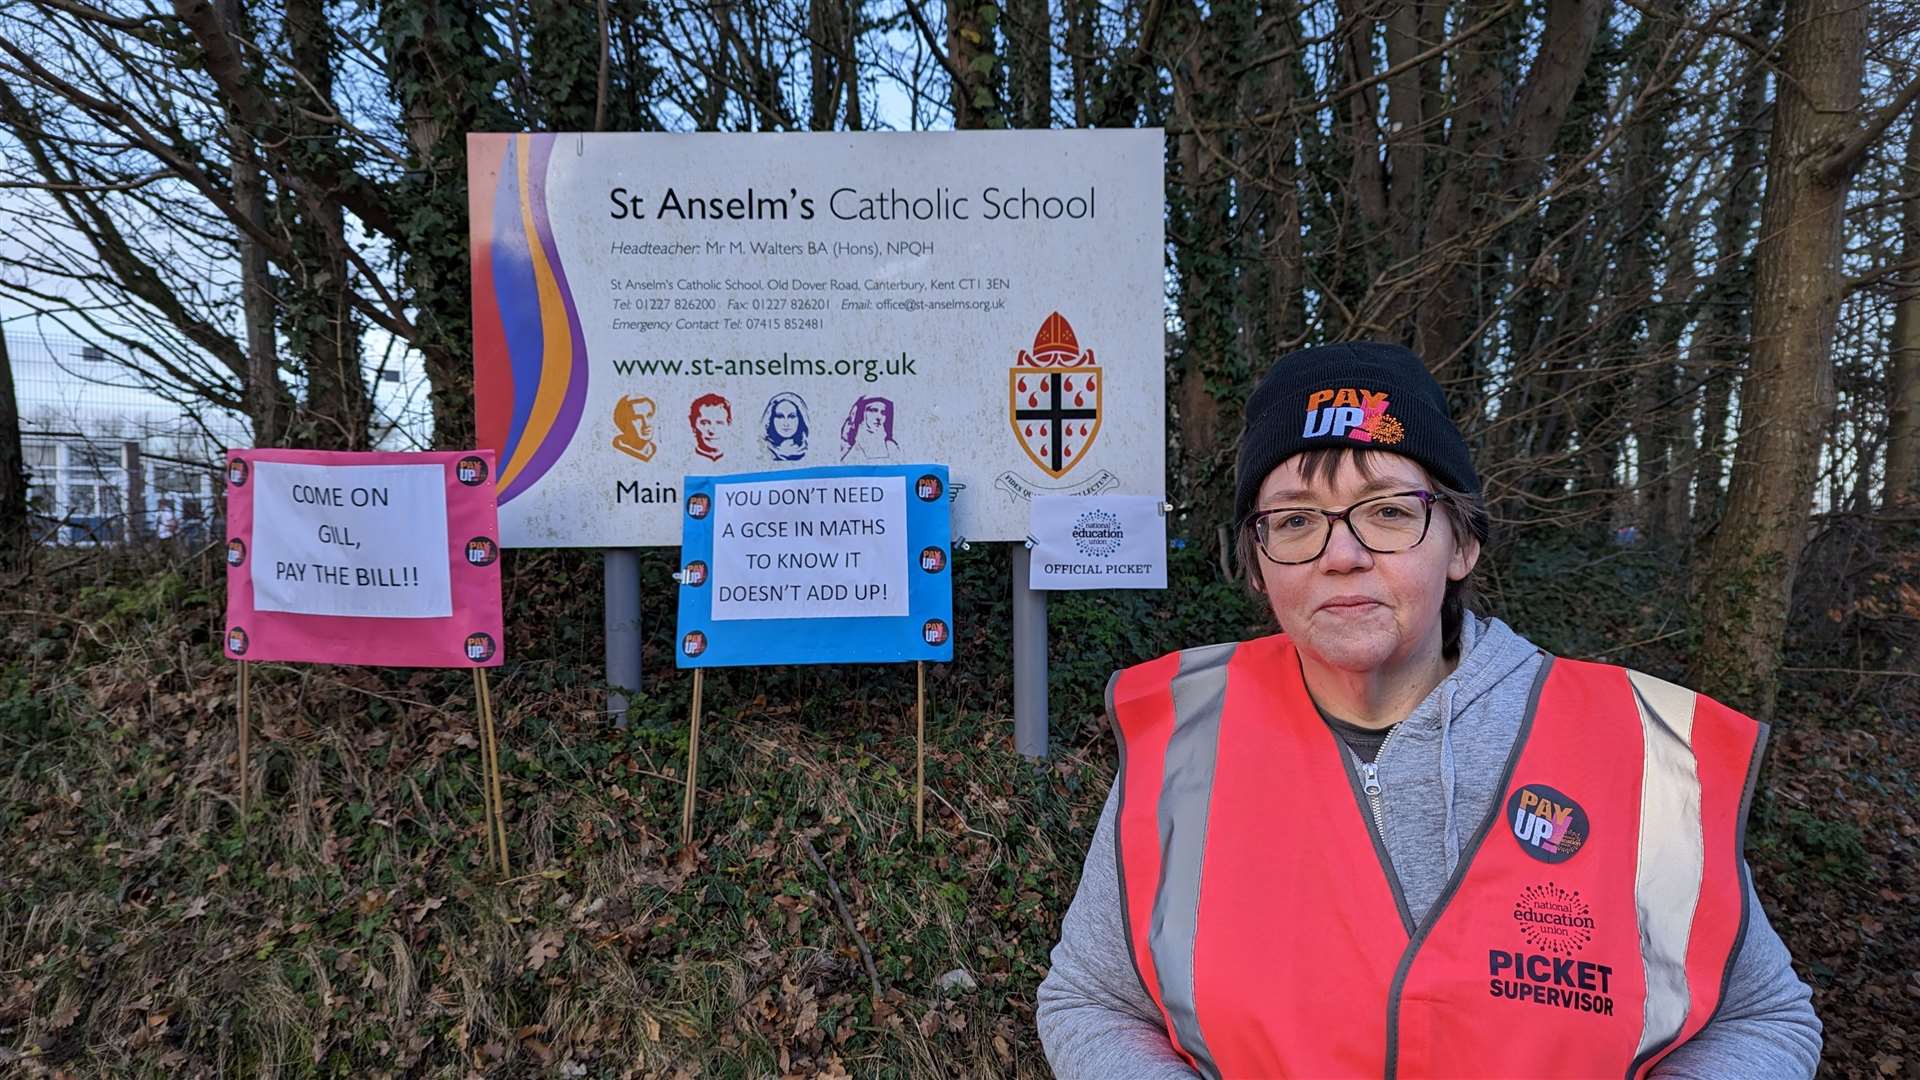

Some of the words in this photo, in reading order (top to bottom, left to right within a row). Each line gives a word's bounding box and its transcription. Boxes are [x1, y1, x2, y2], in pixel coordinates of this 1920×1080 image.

[610, 187, 645, 220] St
[656, 187, 815, 220] Anselm's
[830, 187, 969, 220] Catholic
[983, 186, 1095, 220] School
[610, 241, 701, 255] Headteacher:
[706, 241, 724, 255] Mr
[729, 241, 746, 255] M.
[749, 241, 804, 255] Walters
[807, 241, 829, 255] BA
[832, 240, 882, 258] (Hons),
[886, 241, 934, 256] NPQH
[610, 279, 622, 290] St
[624, 279, 674, 290] Anselm's
[676, 279, 722, 290] Catholic
[767, 279, 789, 290] Old
[792, 279, 827, 290] Dover
[864, 279, 928, 293] Canterbury,
[930, 279, 955, 290] Kent
[958, 278, 981, 290] CT1
[986, 278, 1010, 289] 3EN
[613, 298, 632, 310] Tel:
[635, 298, 671, 310] 01227
[674, 298, 717, 310] 826200
[752, 299, 787, 310] 01227
[790, 299, 830, 310] 826201
[841, 299, 873, 310] Email:
[875, 299, 1006, 312] office@st-anselms.org.uk
[612, 318, 673, 332] Emergency
[675, 318, 720, 330] Contact
[723, 318, 742, 330] Tel:
[745, 318, 781, 330] 07415
[784, 318, 824, 330] 852481
[612, 351, 917, 383] www.st-anselms.org.uk
[1305, 388, 1389, 411] PAY
[460, 460, 481, 469] PAY
[616, 480, 678, 504] Main
[919, 479, 937, 487] PAY
[292, 484, 343, 507] COME
[351, 487, 389, 508] ON
[725, 489, 762, 507] YOU
[768, 487, 828, 506] DON'T
[834, 486, 884, 504] NEED
[318, 524, 361, 550] GILL,
[721, 522, 735, 539] A
[740, 521, 788, 538] GCSE
[794, 520, 814, 537] IN
[819, 518, 886, 536] MATHS
[1072, 527, 1124, 539] education
[469, 541, 490, 549] PAY
[923, 550, 940, 558] PAY
[746, 552, 772, 570] TO
[777, 552, 839, 569] KNOW
[845, 551, 862, 568] IT
[1044, 563, 1103, 575] OFFICIAL
[1105, 564, 1153, 574] PICKET
[276, 561, 307, 582] PAY
[312, 564, 350, 586] THE
[356, 566, 420, 587] BILL!!
[718, 584, 801, 603] DOESN'T
[806, 583, 848, 601] ADD
[854, 583, 888, 601] UP!
[925, 622, 943, 630] PAY
[468, 637, 488, 645] PAY
[1519, 788, 1574, 825] PAY
[1533, 899, 1573, 914] national
[1513, 908, 1596, 930] education
[1539, 925, 1570, 937] union
[1488, 949, 1613, 995] PICKET
[1489, 978, 1614, 1017] SUPERVISOR
